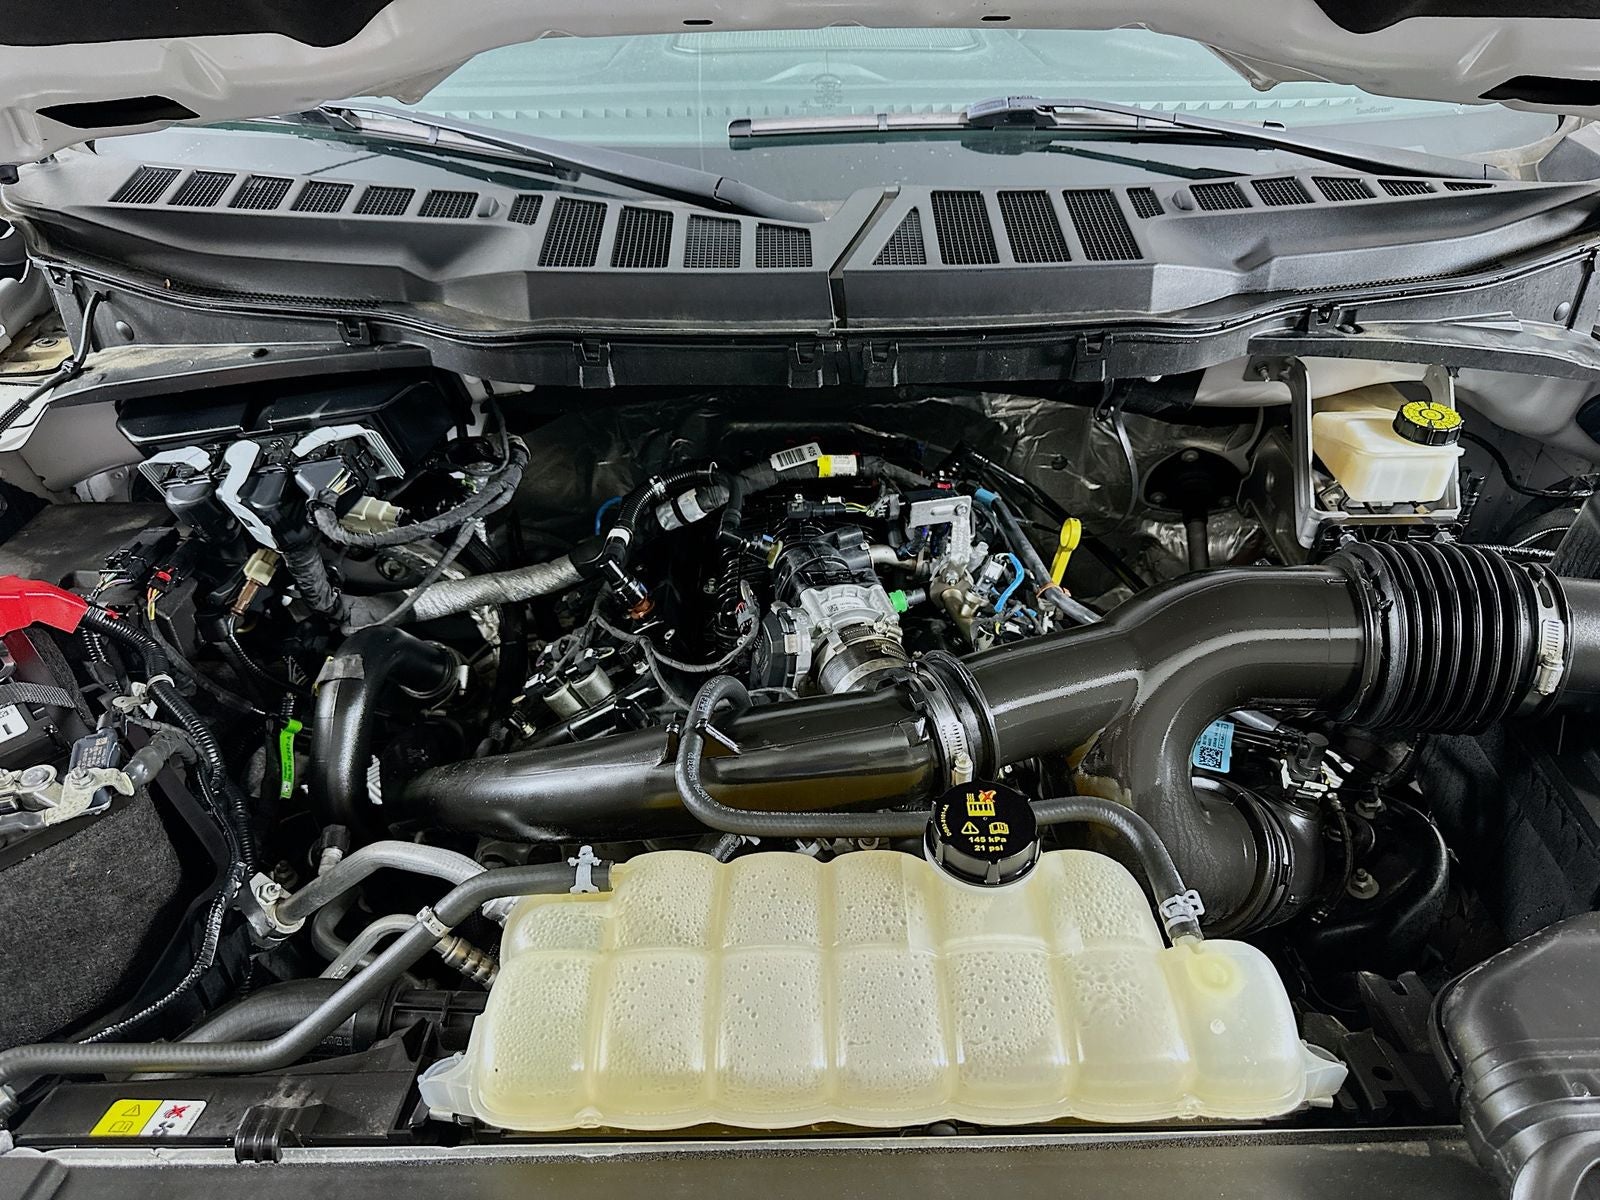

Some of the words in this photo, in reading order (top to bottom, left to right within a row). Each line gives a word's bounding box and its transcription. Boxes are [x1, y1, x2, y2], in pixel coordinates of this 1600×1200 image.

[968, 836, 986, 844] 145
[987, 836, 1007, 844] kPa
[974, 844, 985, 852] 21
[988, 844, 1004, 853] psi
